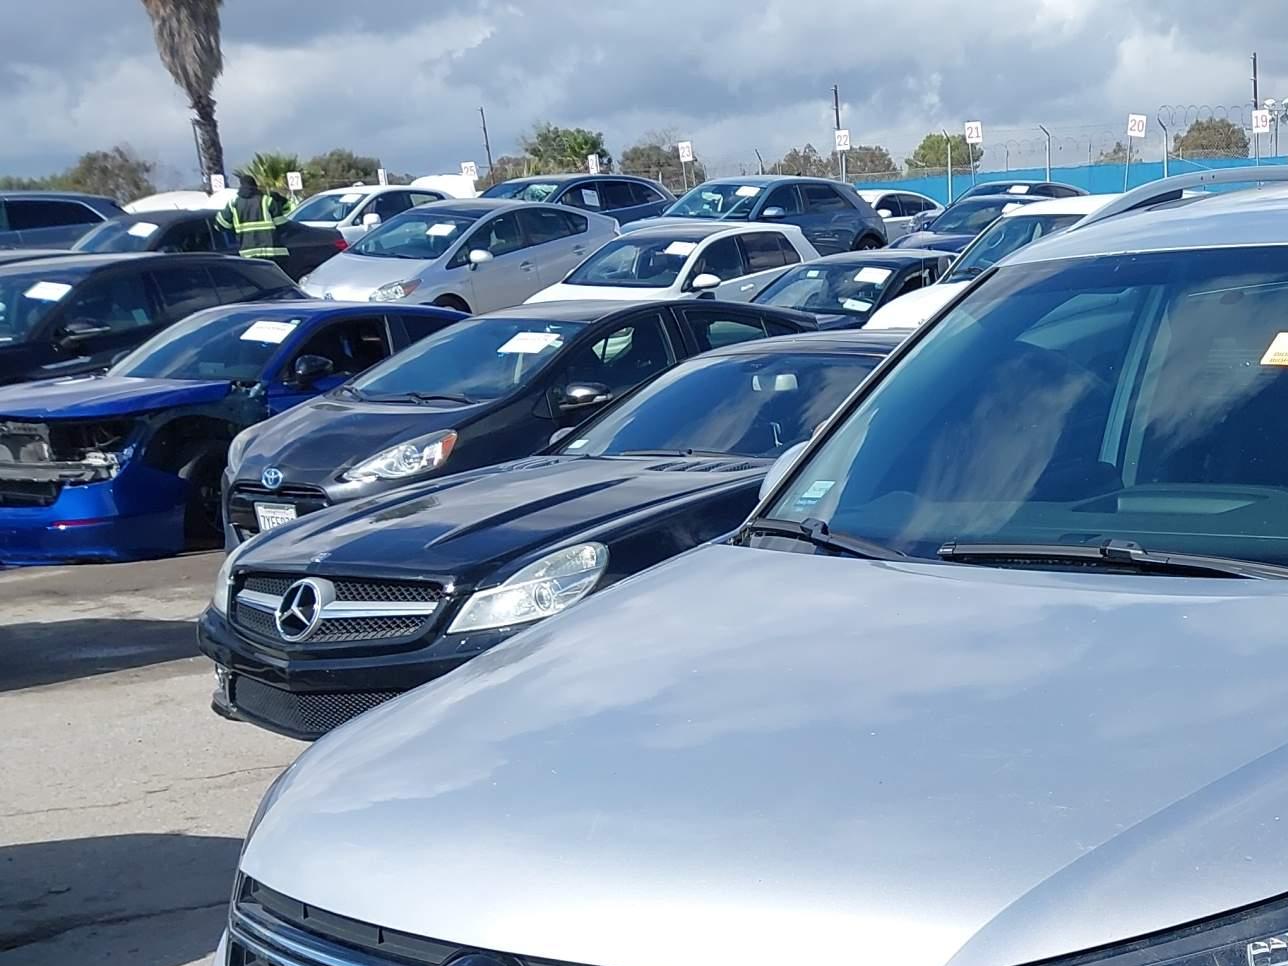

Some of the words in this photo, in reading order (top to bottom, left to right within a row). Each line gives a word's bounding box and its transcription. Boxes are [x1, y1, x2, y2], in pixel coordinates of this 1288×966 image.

[1129, 119, 1145, 133] 20
[1254, 114, 1268, 129] 19
[966, 126, 981, 139] 21
[836, 134, 849, 147] 22
[680, 145, 691, 159] 23
[288, 175, 301, 187] 27
